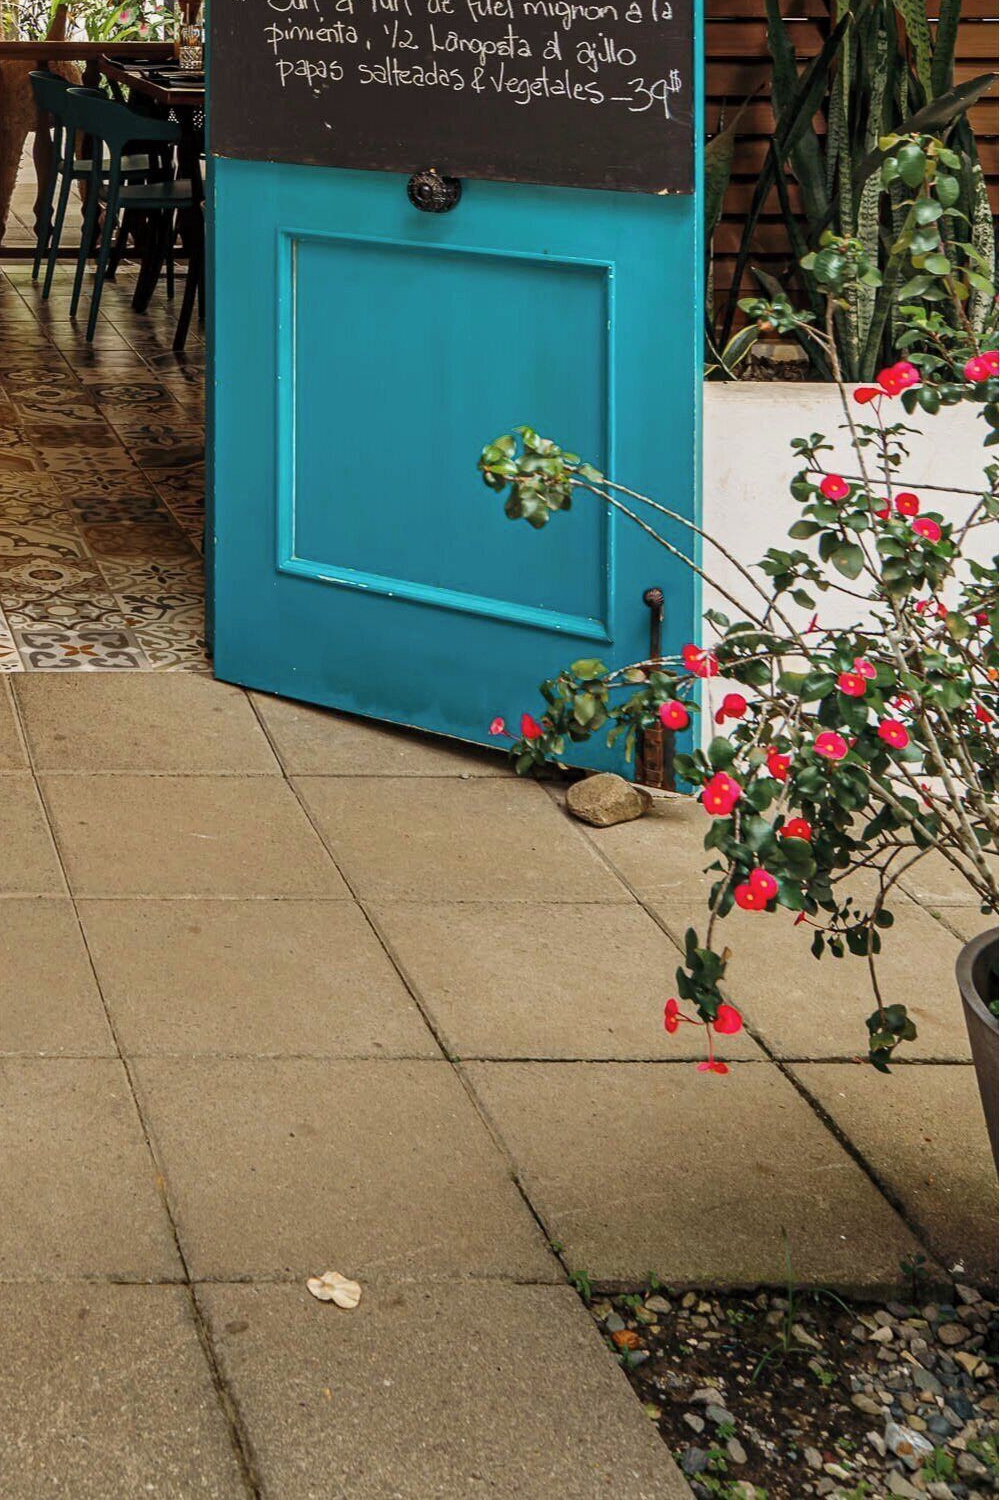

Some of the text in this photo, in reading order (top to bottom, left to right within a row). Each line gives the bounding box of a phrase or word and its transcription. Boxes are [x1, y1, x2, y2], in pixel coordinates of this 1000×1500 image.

[625, 1, 643, 23] a
[542, 31, 562, 61] al
[576, 32, 637, 73] ajillo
[276, 59, 344, 87] papas
[358, 56, 465, 91] salteadas
[471, 66, 486, 93] &
